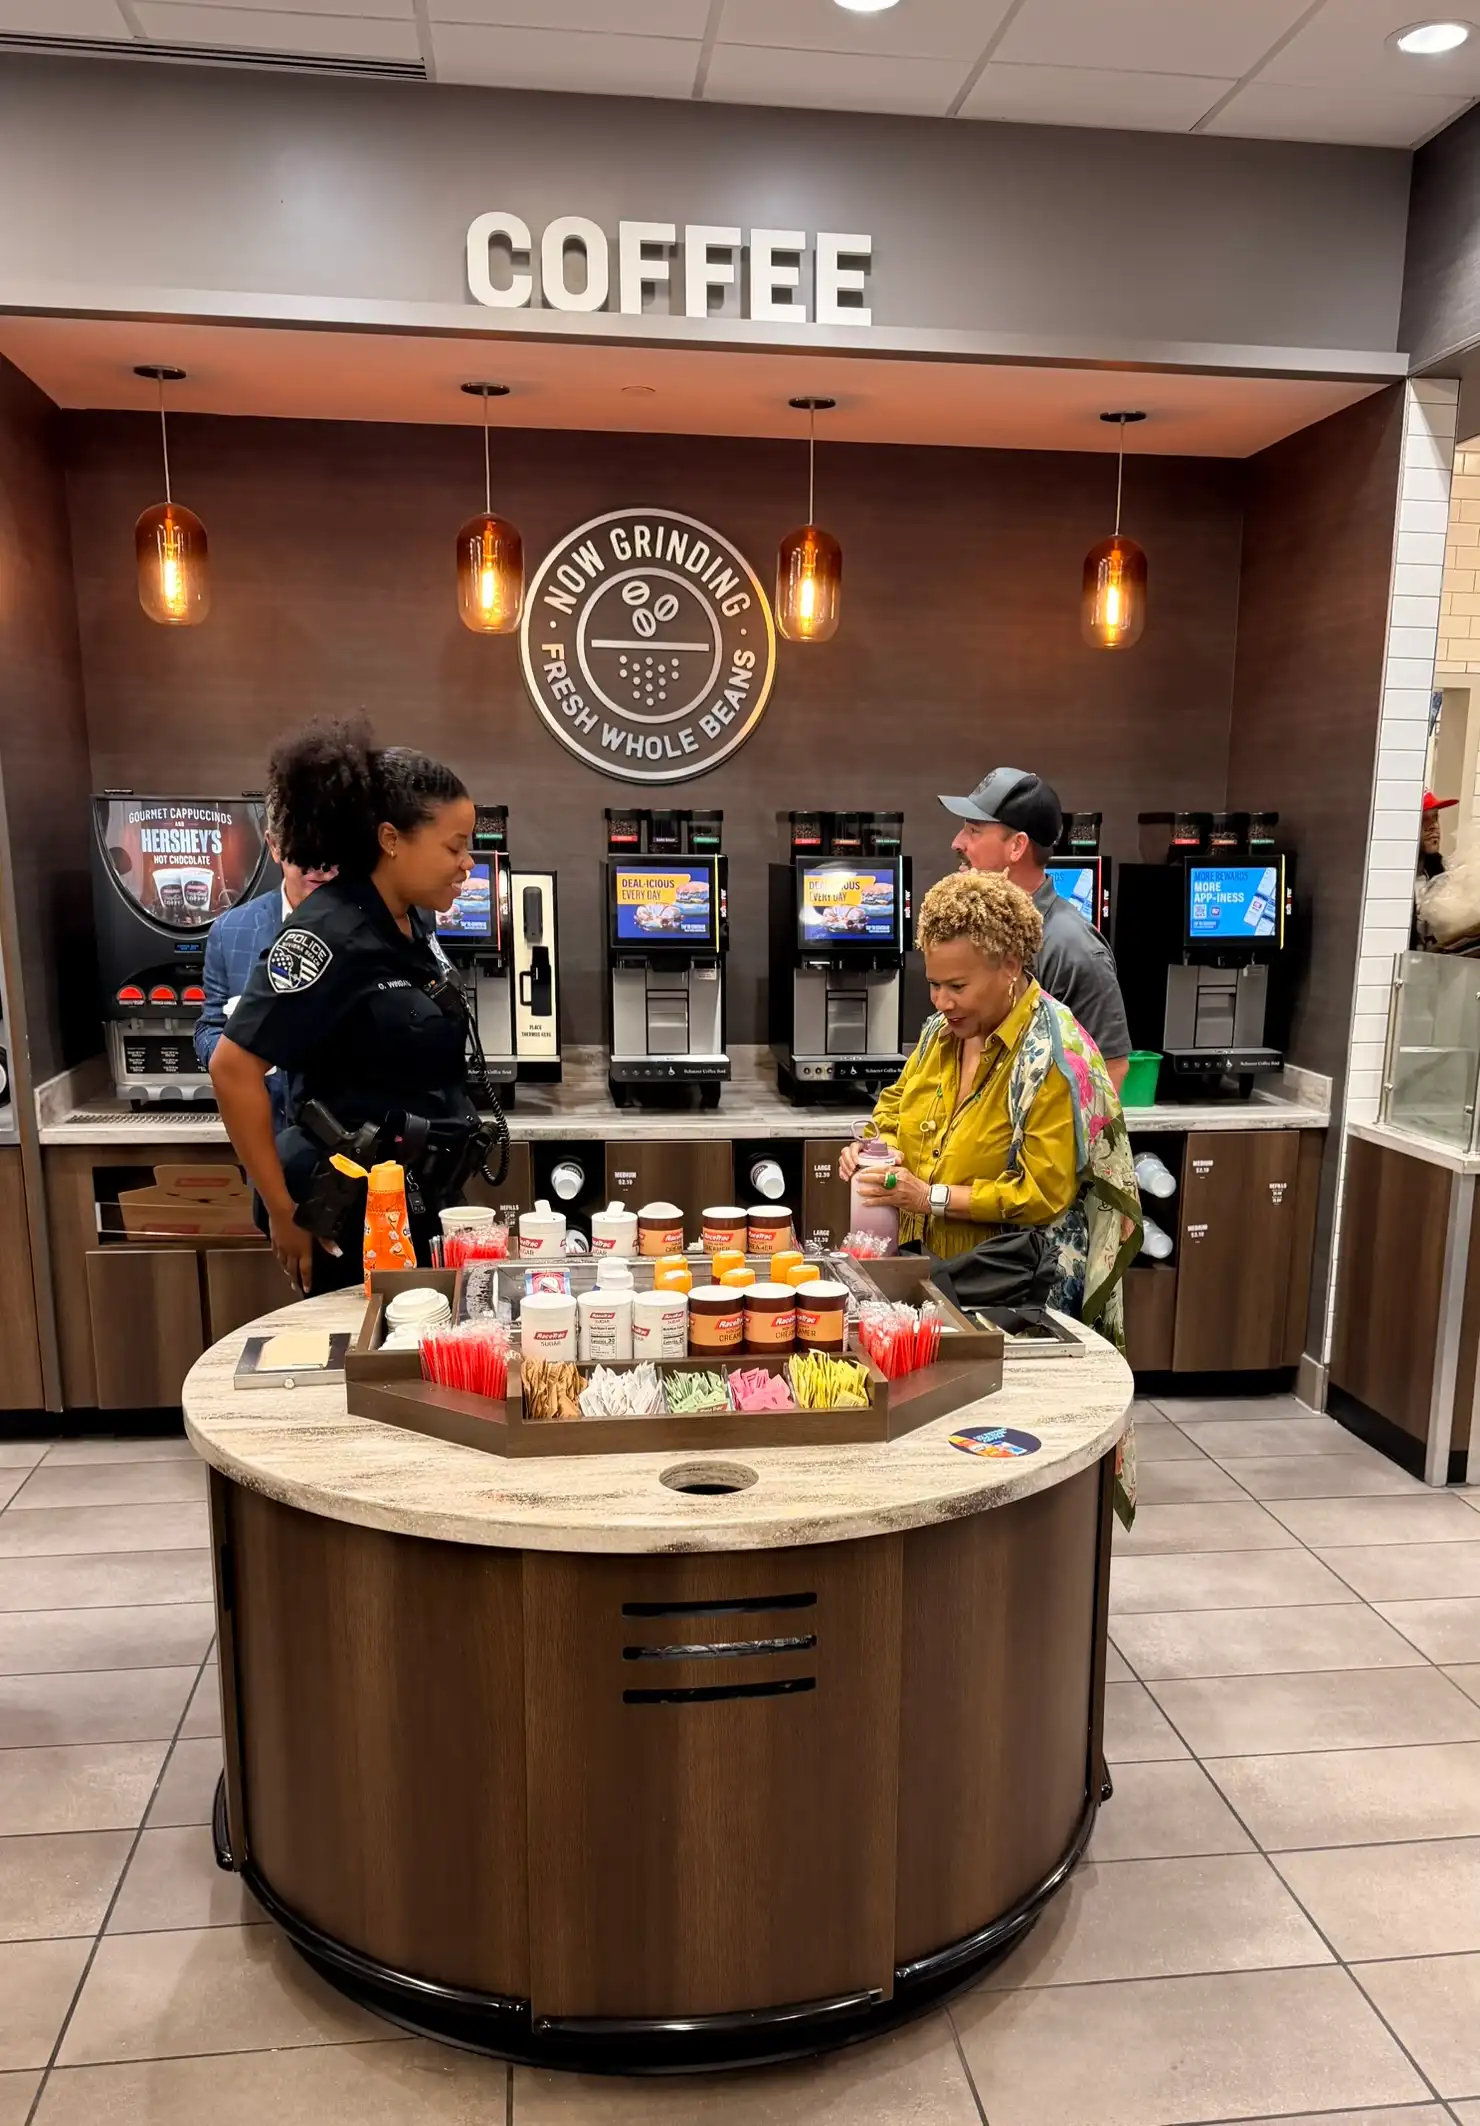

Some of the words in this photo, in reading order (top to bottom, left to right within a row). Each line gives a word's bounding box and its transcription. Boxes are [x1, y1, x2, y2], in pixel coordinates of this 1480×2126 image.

[467, 211, 872, 326] COFFEE
[544, 540, 605, 614] NOW
[610, 525, 751, 617] GRINDING
[541, 643, 598, 733] FRESH
[601, 723, 699, 760] WHOLE
[698, 649, 756, 739] BEANS
[129, 808, 167, 823] GOURMET
[170, 808, 232, 825] CAPPUCCINOS
[141, 829, 223, 854] HERSHEY'S
[153, 855, 167, 864] HOT
[169, 855, 211, 865] CHOCOLATE
[1194, 871, 1214, 881] MORE
[1215, 871, 1249, 881] REWARDS
[622, 879, 675, 889] DEAL-ICIOUS
[1194, 882, 1221, 892] MORE
[622, 890, 645, 900] EVERY
[647, 890, 662, 900] DAY
[1194, 892, 1245, 903] APP-INESS
[285, 933, 327, 962] POLICE
[536, 1331, 566, 1340] RaceTrac
